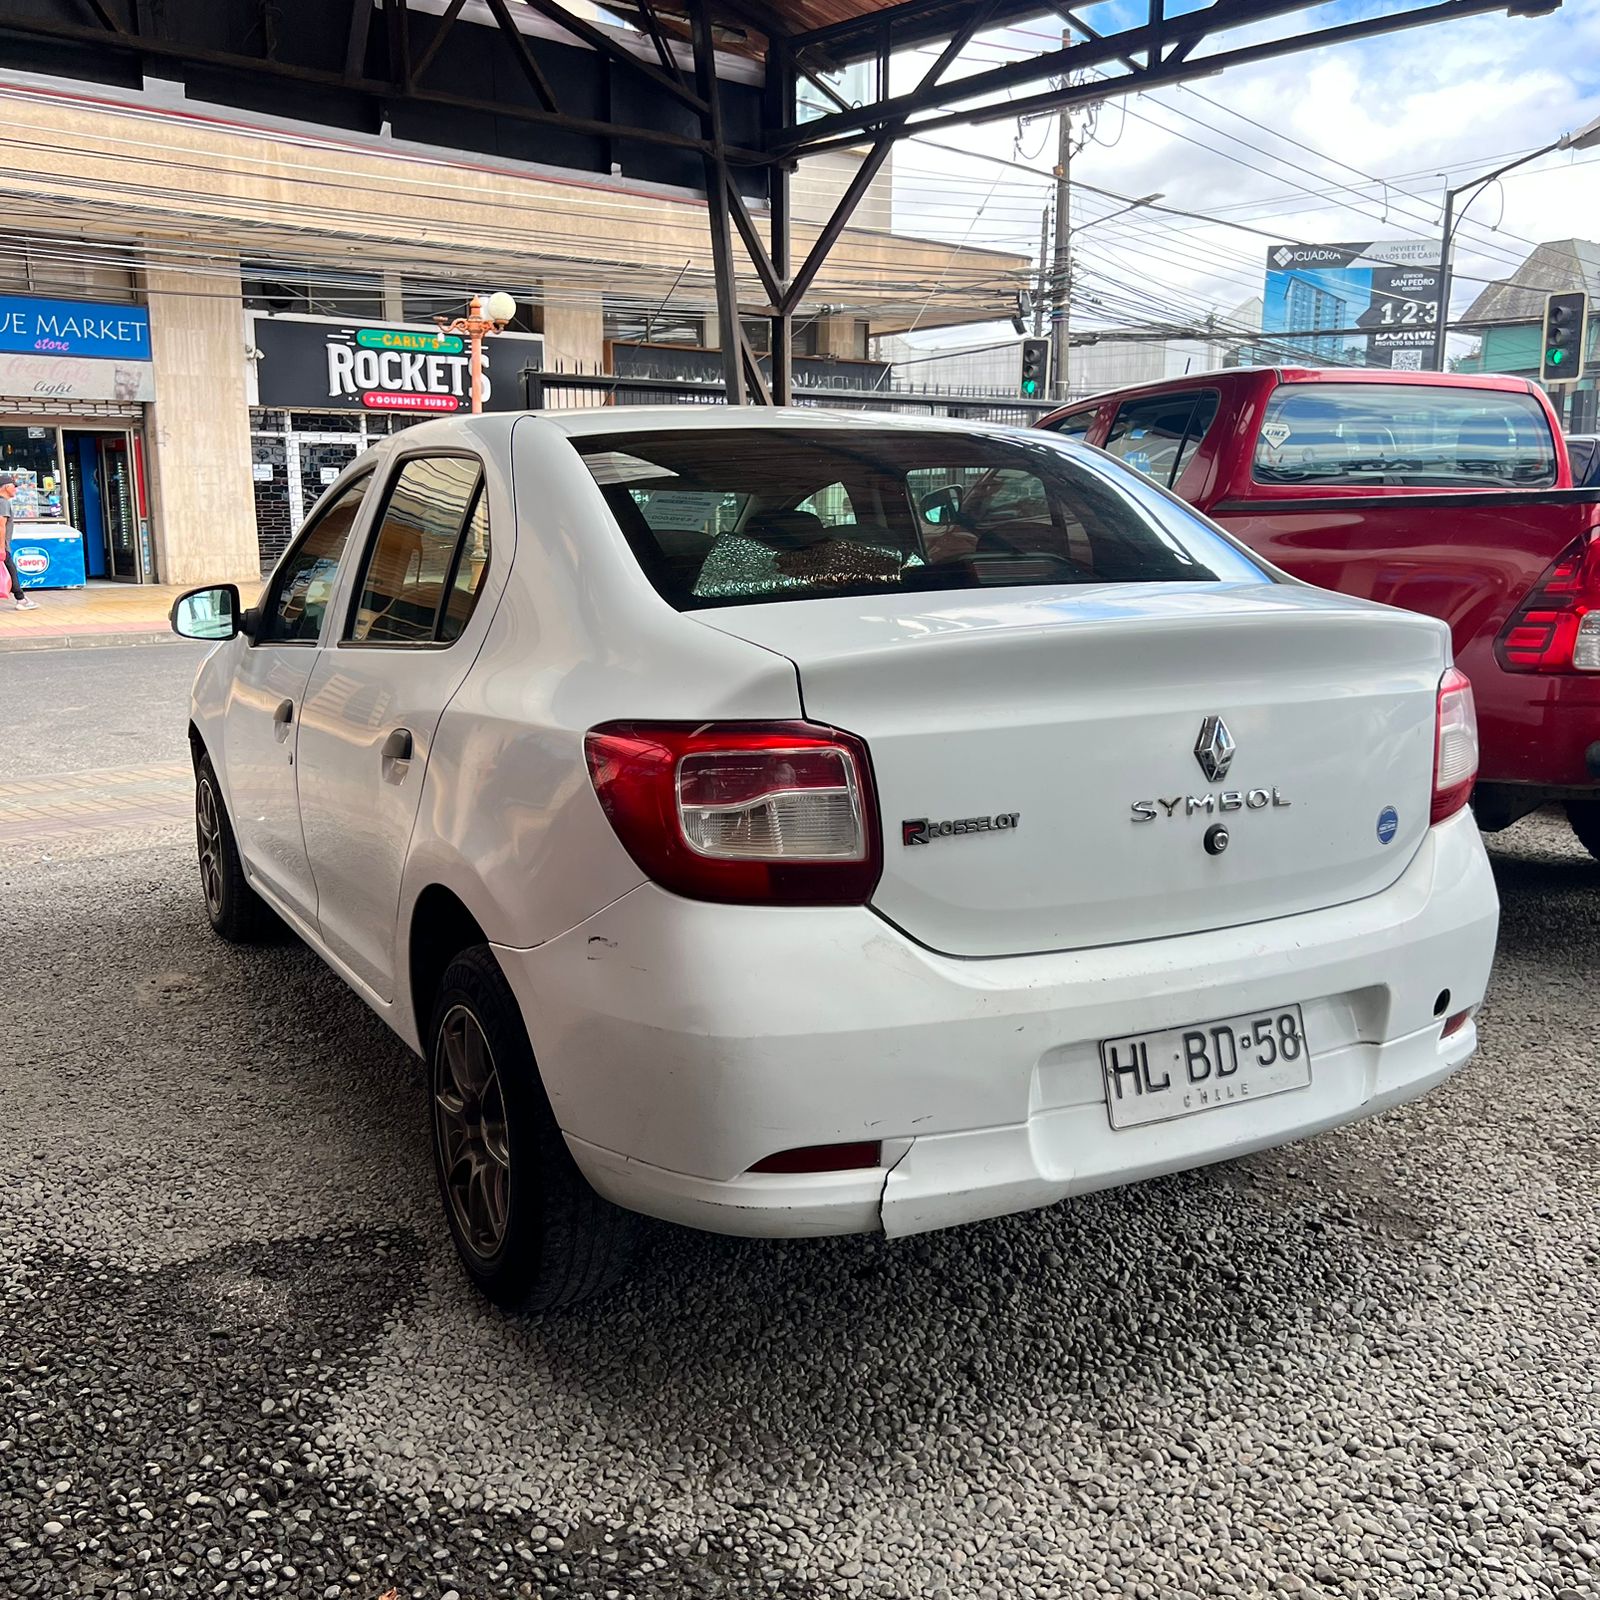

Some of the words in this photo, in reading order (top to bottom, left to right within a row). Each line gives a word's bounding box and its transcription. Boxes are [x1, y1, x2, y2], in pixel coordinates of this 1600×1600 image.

[1391, 244, 1425, 252] INVIERTE
[1418, 251, 1440, 259] CASIN
[1390, 279, 1407, 287] SAN
[1408, 278, 1435, 286] PEDRO
[36, 314, 147, 342] MARKET
[34, 338, 70, 351] store
[382, 334, 440, 349] CARLY'S
[325, 342, 492, 403] ROCKETS
[33, 380, 73, 395] light
[376, 395, 421, 406] GOURMET
[424, 397, 447, 407] SUBS
[18, 557, 46, 568] Savory
[1131, 785, 1292, 823] SYMBOL
[1183, 1083, 1250, 1108] CHILE
